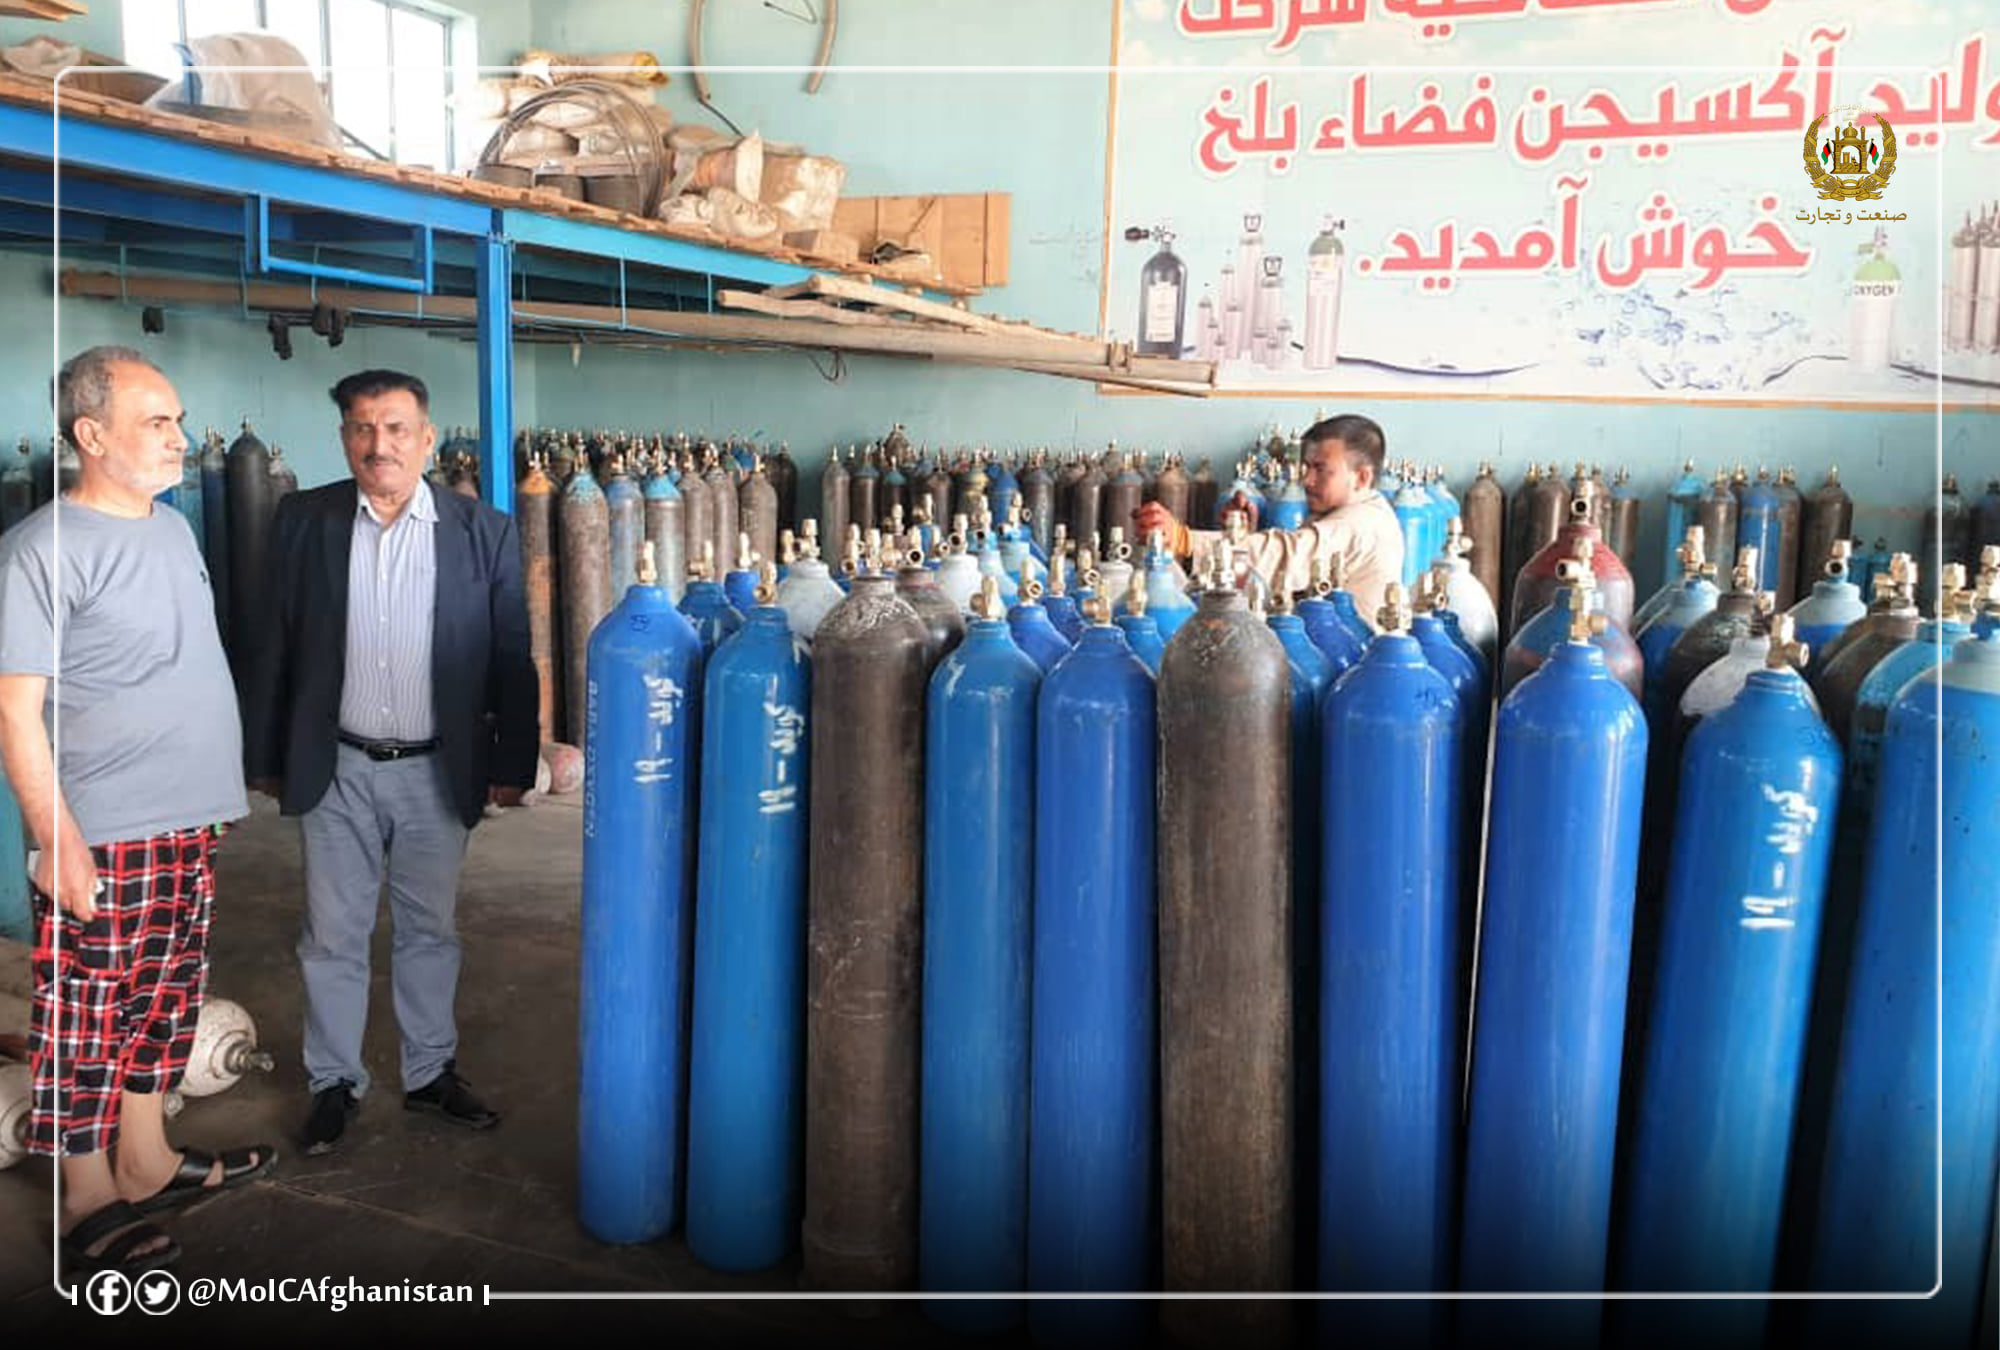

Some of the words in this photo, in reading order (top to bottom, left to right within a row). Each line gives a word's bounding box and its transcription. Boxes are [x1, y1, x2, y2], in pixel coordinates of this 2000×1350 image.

[1199, 79, 1298, 173] بلخ
[1314, 73, 1498, 150] فضاء
[1597, 195, 1812, 289] خوش
